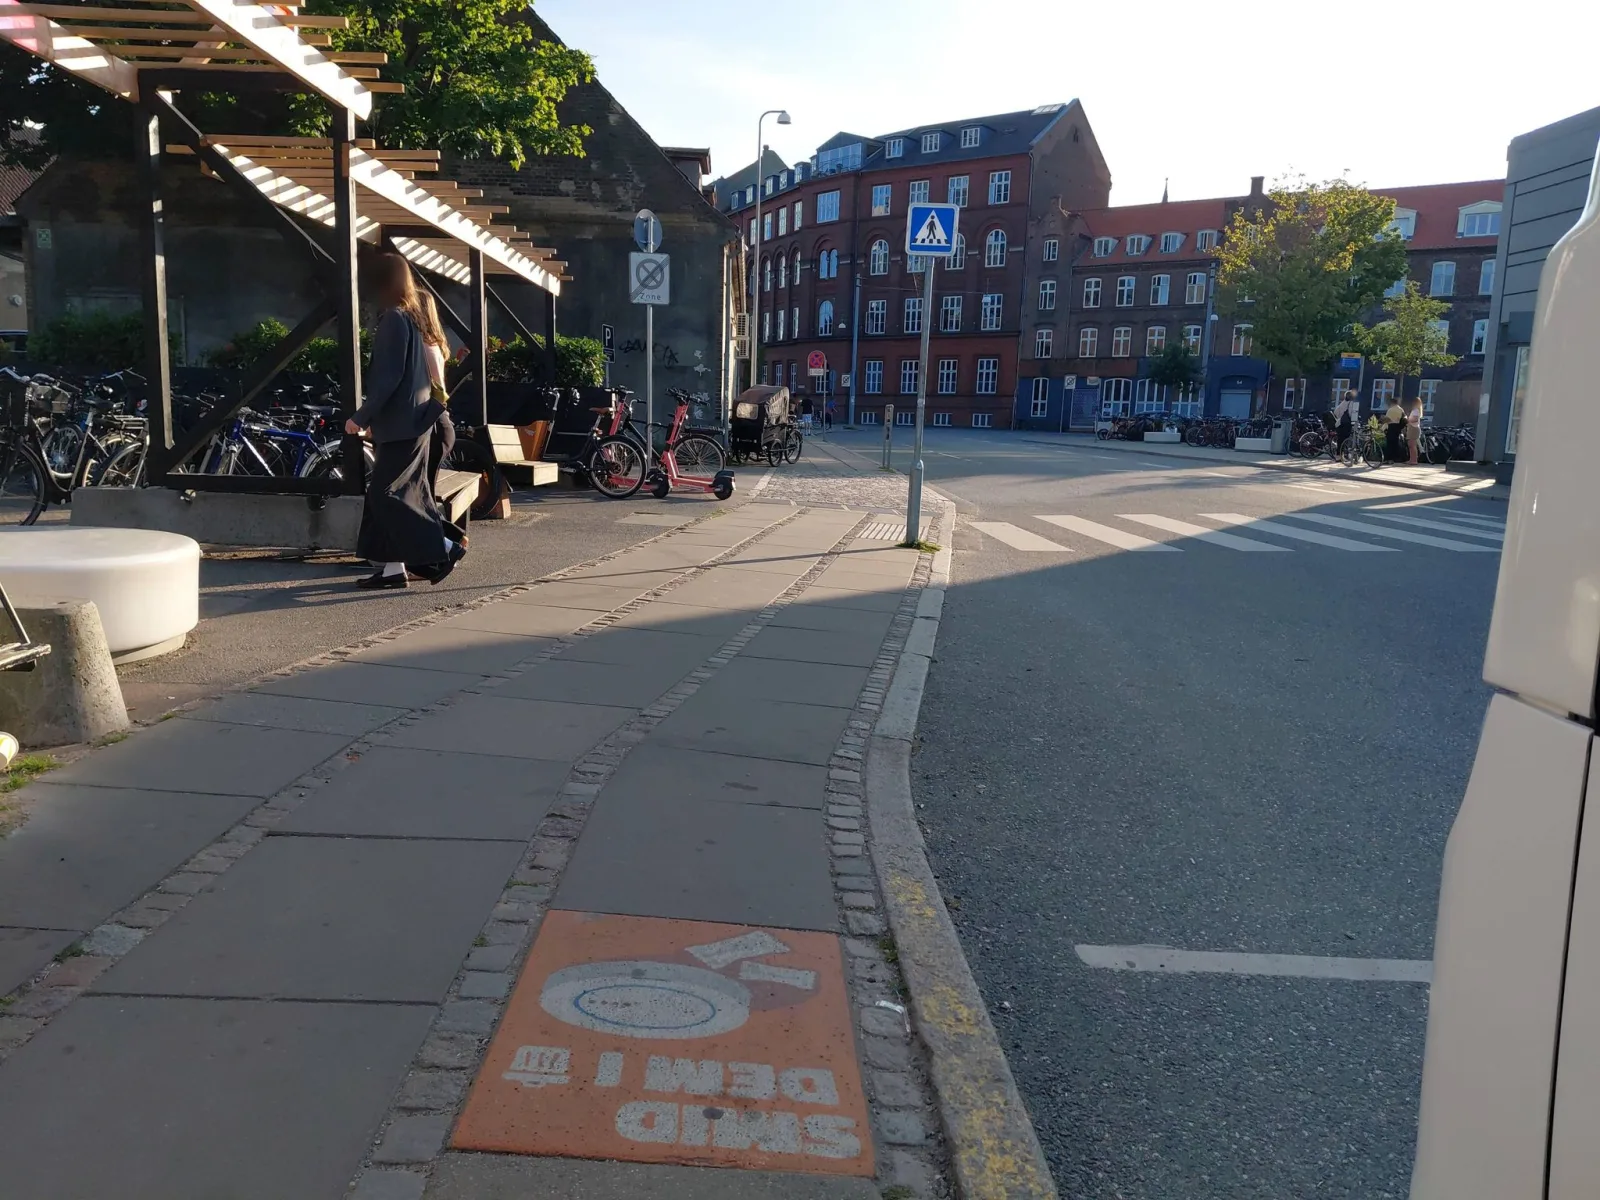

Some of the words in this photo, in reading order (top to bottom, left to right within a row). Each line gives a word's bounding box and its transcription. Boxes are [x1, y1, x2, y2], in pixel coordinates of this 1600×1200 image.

[640, 292, 662, 301] Zone
[605, 327, 611, 347] P
[594, 1050, 624, 1087] I
[643, 1054, 839, 1106] DEM
[615, 1100, 861, 1158] SMID
